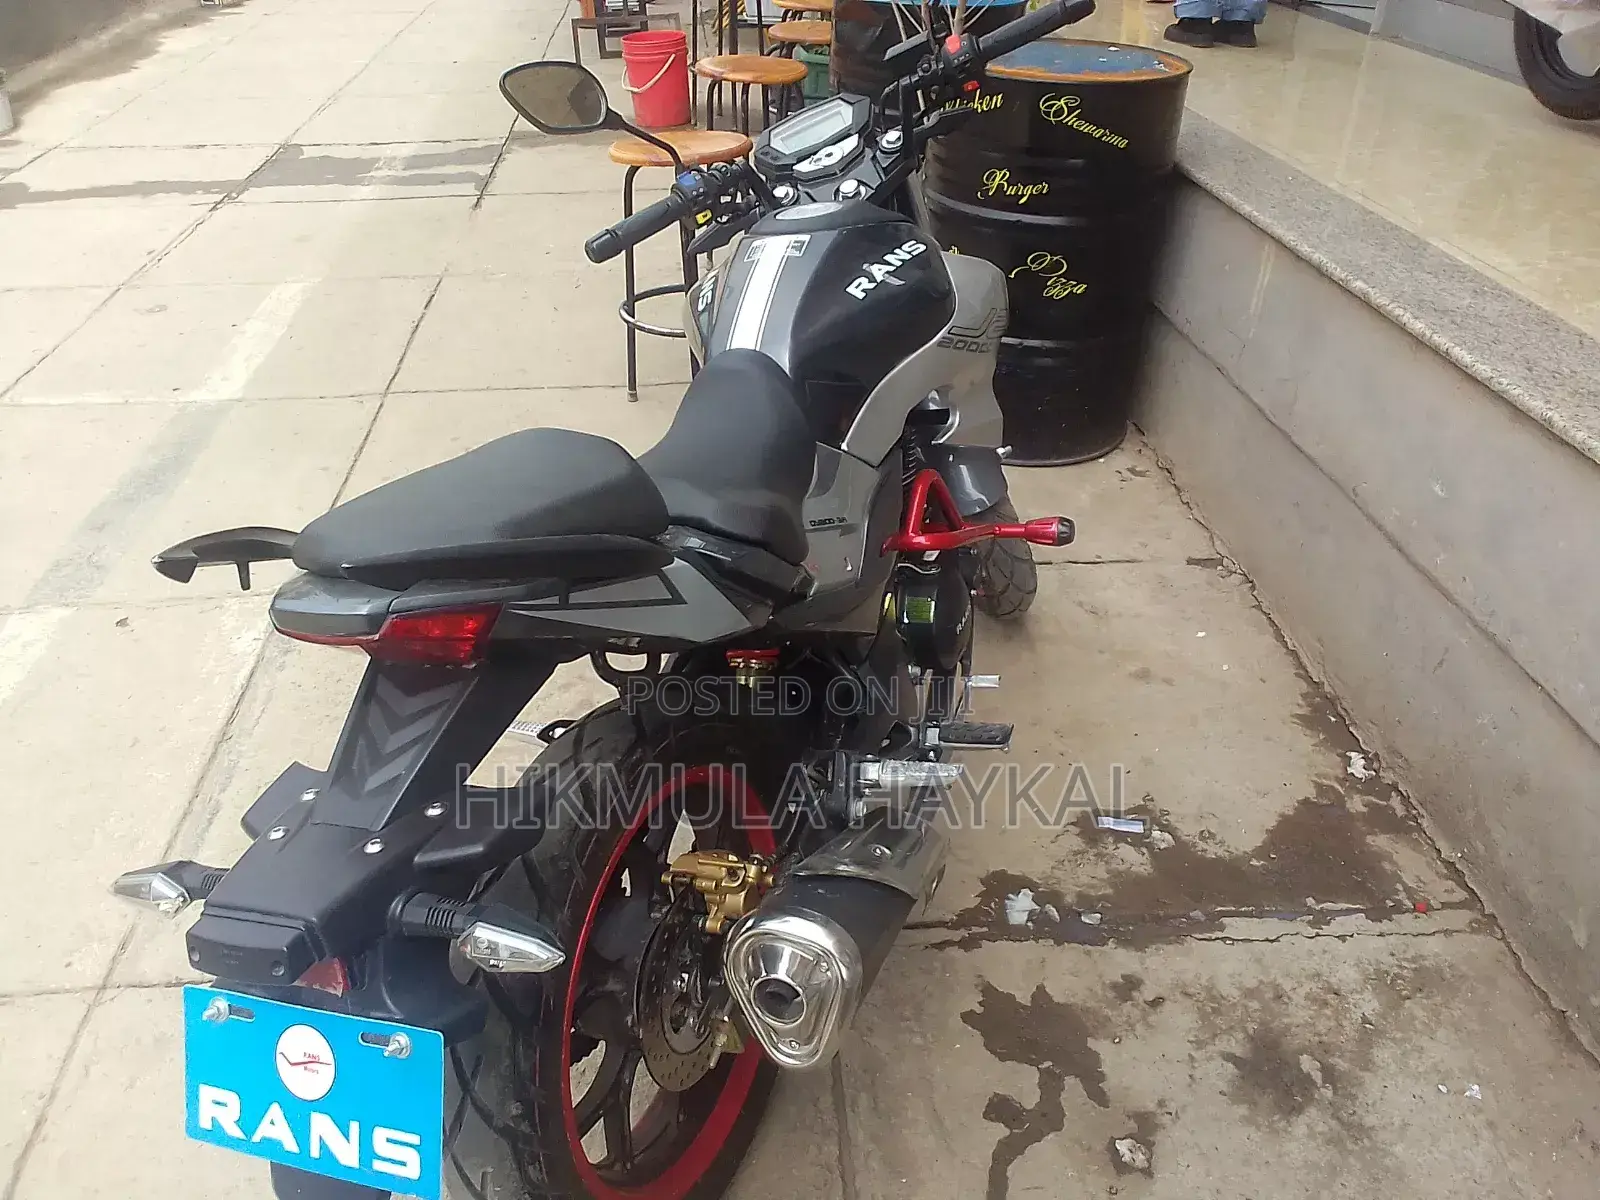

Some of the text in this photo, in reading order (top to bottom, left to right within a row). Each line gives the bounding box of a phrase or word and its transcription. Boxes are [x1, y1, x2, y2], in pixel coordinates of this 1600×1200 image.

[977, 168, 1050, 205] Burger
[845, 239, 928, 301] RANS
[1008, 251, 1088, 300] Pizza
[303, 1051, 321, 1062] RANS
[198, 1083, 421, 1181] RANS
